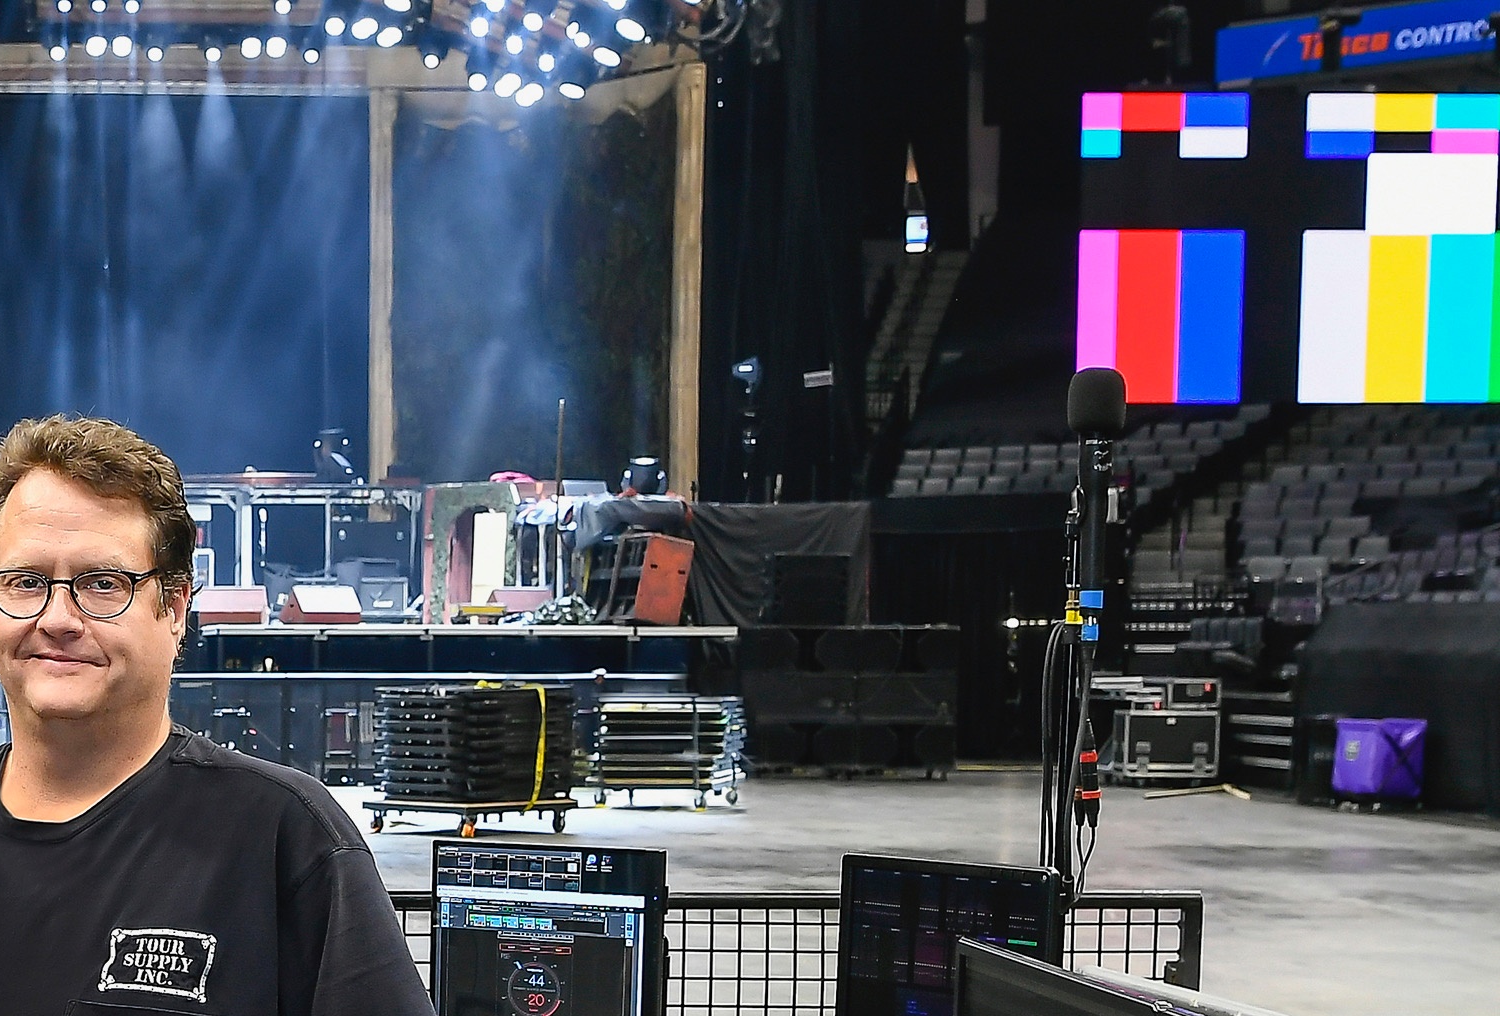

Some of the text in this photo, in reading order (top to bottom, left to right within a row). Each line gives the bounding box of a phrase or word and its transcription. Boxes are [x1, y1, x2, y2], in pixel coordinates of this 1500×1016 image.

[1395, 19, 1497, 50] CONTRO
[135, 937, 186, 956] TOUR
[122, 953, 194, 974] SUPPLY
[134, 969, 173, 986] INC.
